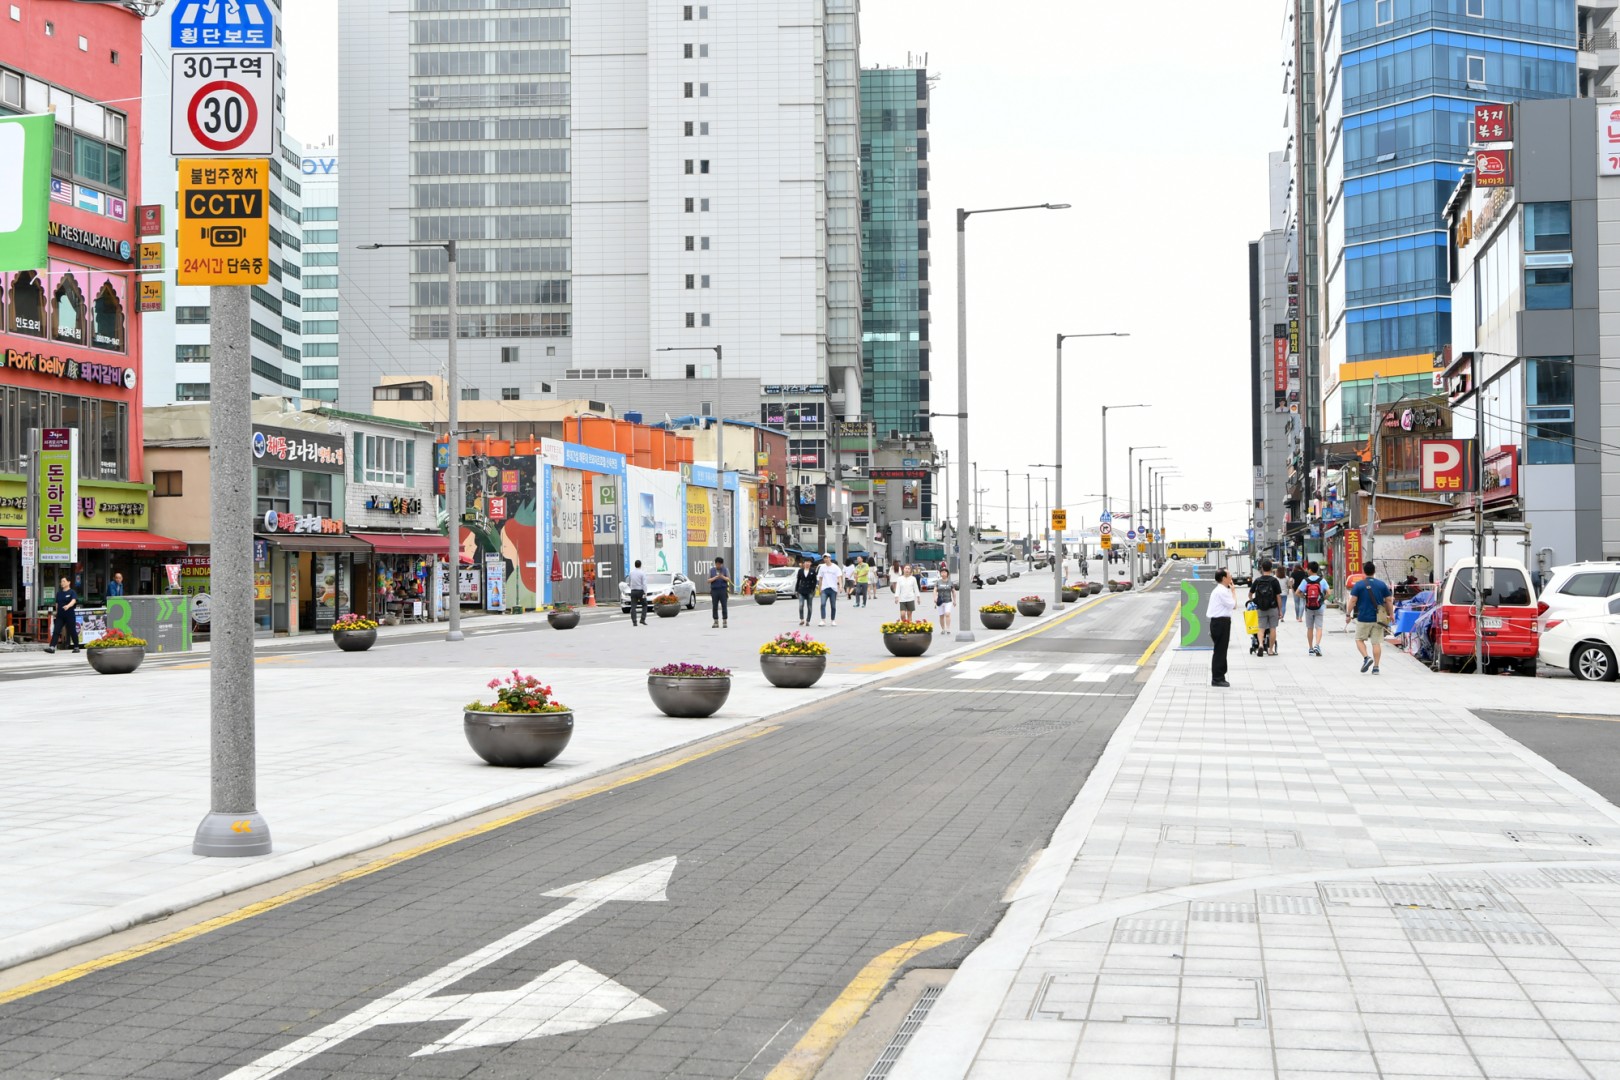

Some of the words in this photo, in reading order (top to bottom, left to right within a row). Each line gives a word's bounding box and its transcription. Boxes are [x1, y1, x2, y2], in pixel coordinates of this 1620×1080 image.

[180, 27, 265, 45] 횡단보도
[183, 56, 262, 79] 30구역
[204, 96, 243, 134] 30
[1477, 109, 1503, 122] 낙지
[1478, 124, 1504, 138] 볶음
[190, 167, 258, 186] 불법주정차
[190, 193, 256, 216] CCTV
[60, 224, 119, 254] RESTAURANT
[183, 257, 224, 275] 24시간
[227, 256, 264, 275] 단속중
[15, 316, 41, 332] 인도요리
[8, 349, 36, 371] Pork
[38, 354, 66, 378] belly
[81, 362, 122, 386] 돼지갈비
[1422, 443, 1461, 489] P
[1435, 476, 1461, 489] 동남
[47, 464, 64, 543] 돈하루방
[491, 499, 504, 515] 열쇠
[1347, 531, 1360, 572] 조개구이
